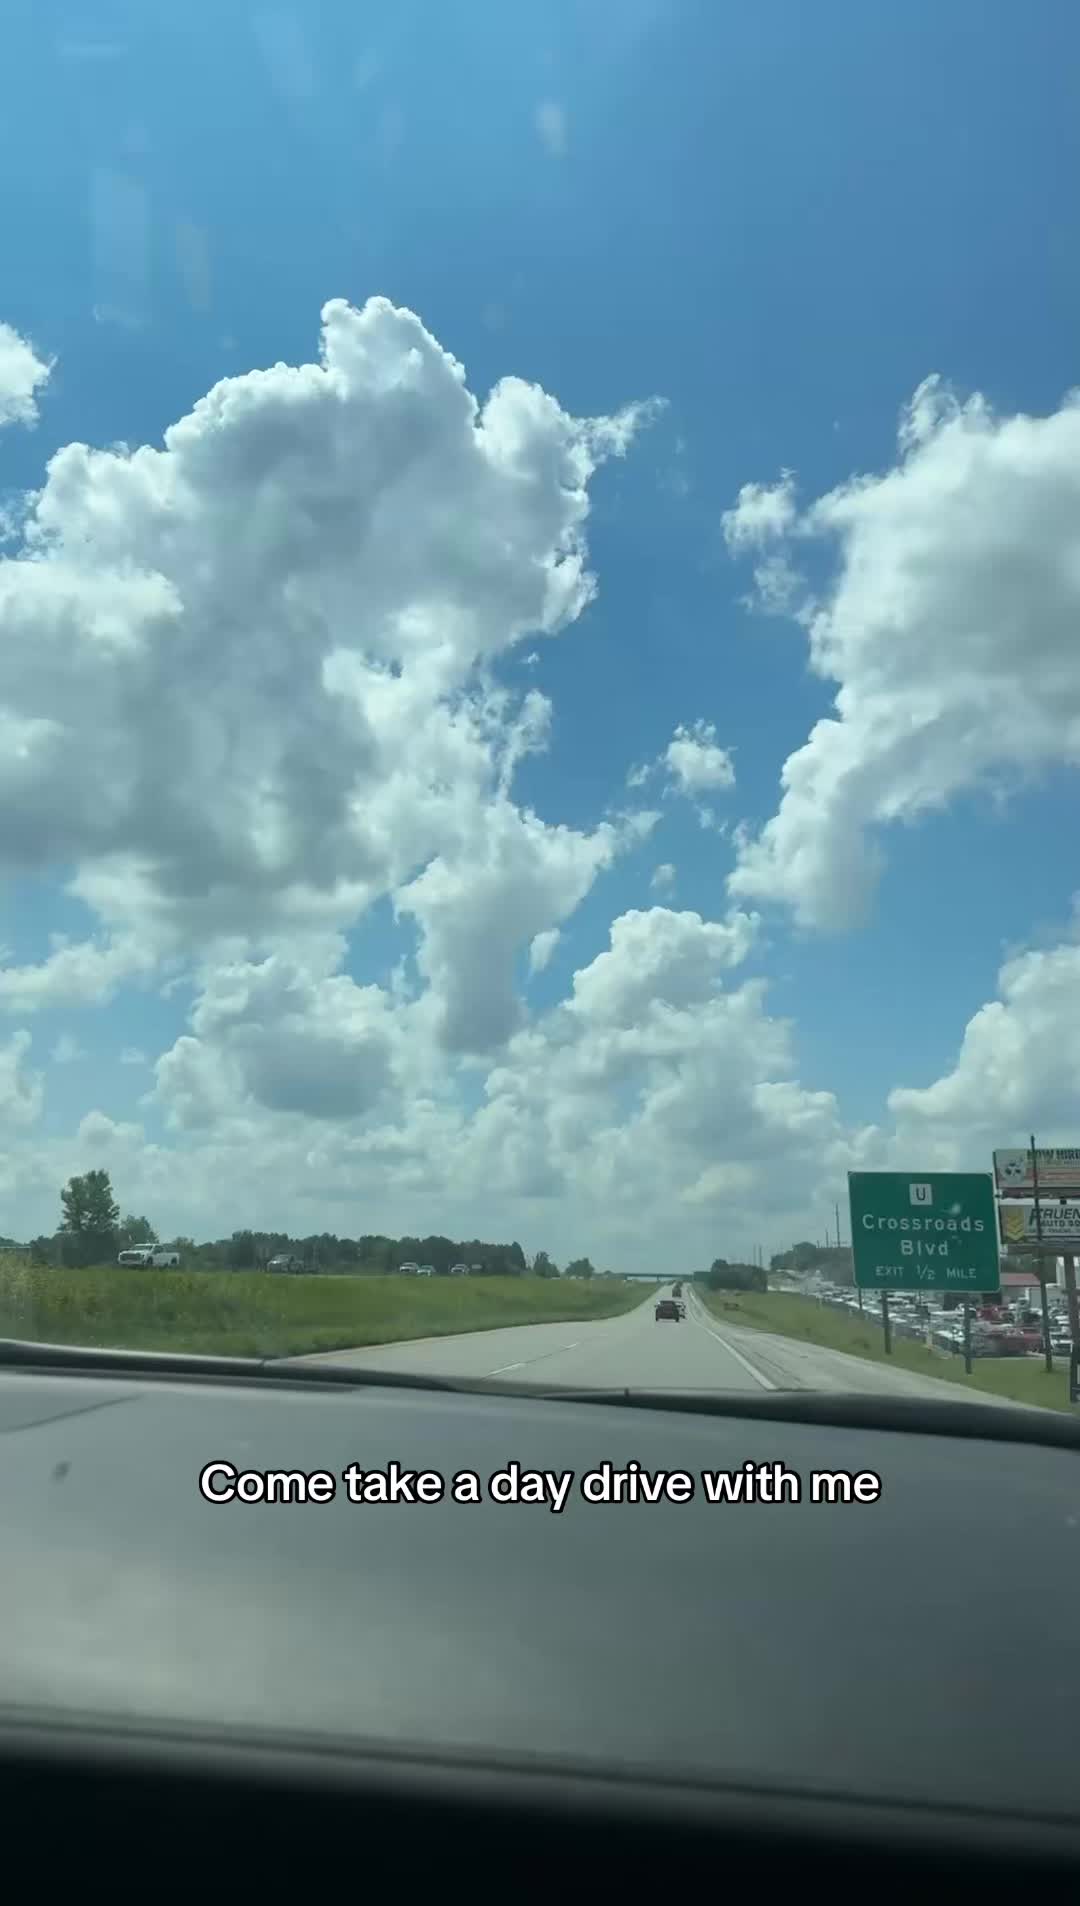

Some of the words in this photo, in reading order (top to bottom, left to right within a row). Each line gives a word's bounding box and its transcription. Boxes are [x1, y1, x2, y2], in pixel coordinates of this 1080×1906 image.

[915, 1187, 926, 1201] U
[862, 1214, 984, 1231] Crossroads
[901, 1239, 949, 1256] Blvd
[875, 1265, 904, 1277] EXIT
[946, 1268, 977, 1279] MILE
